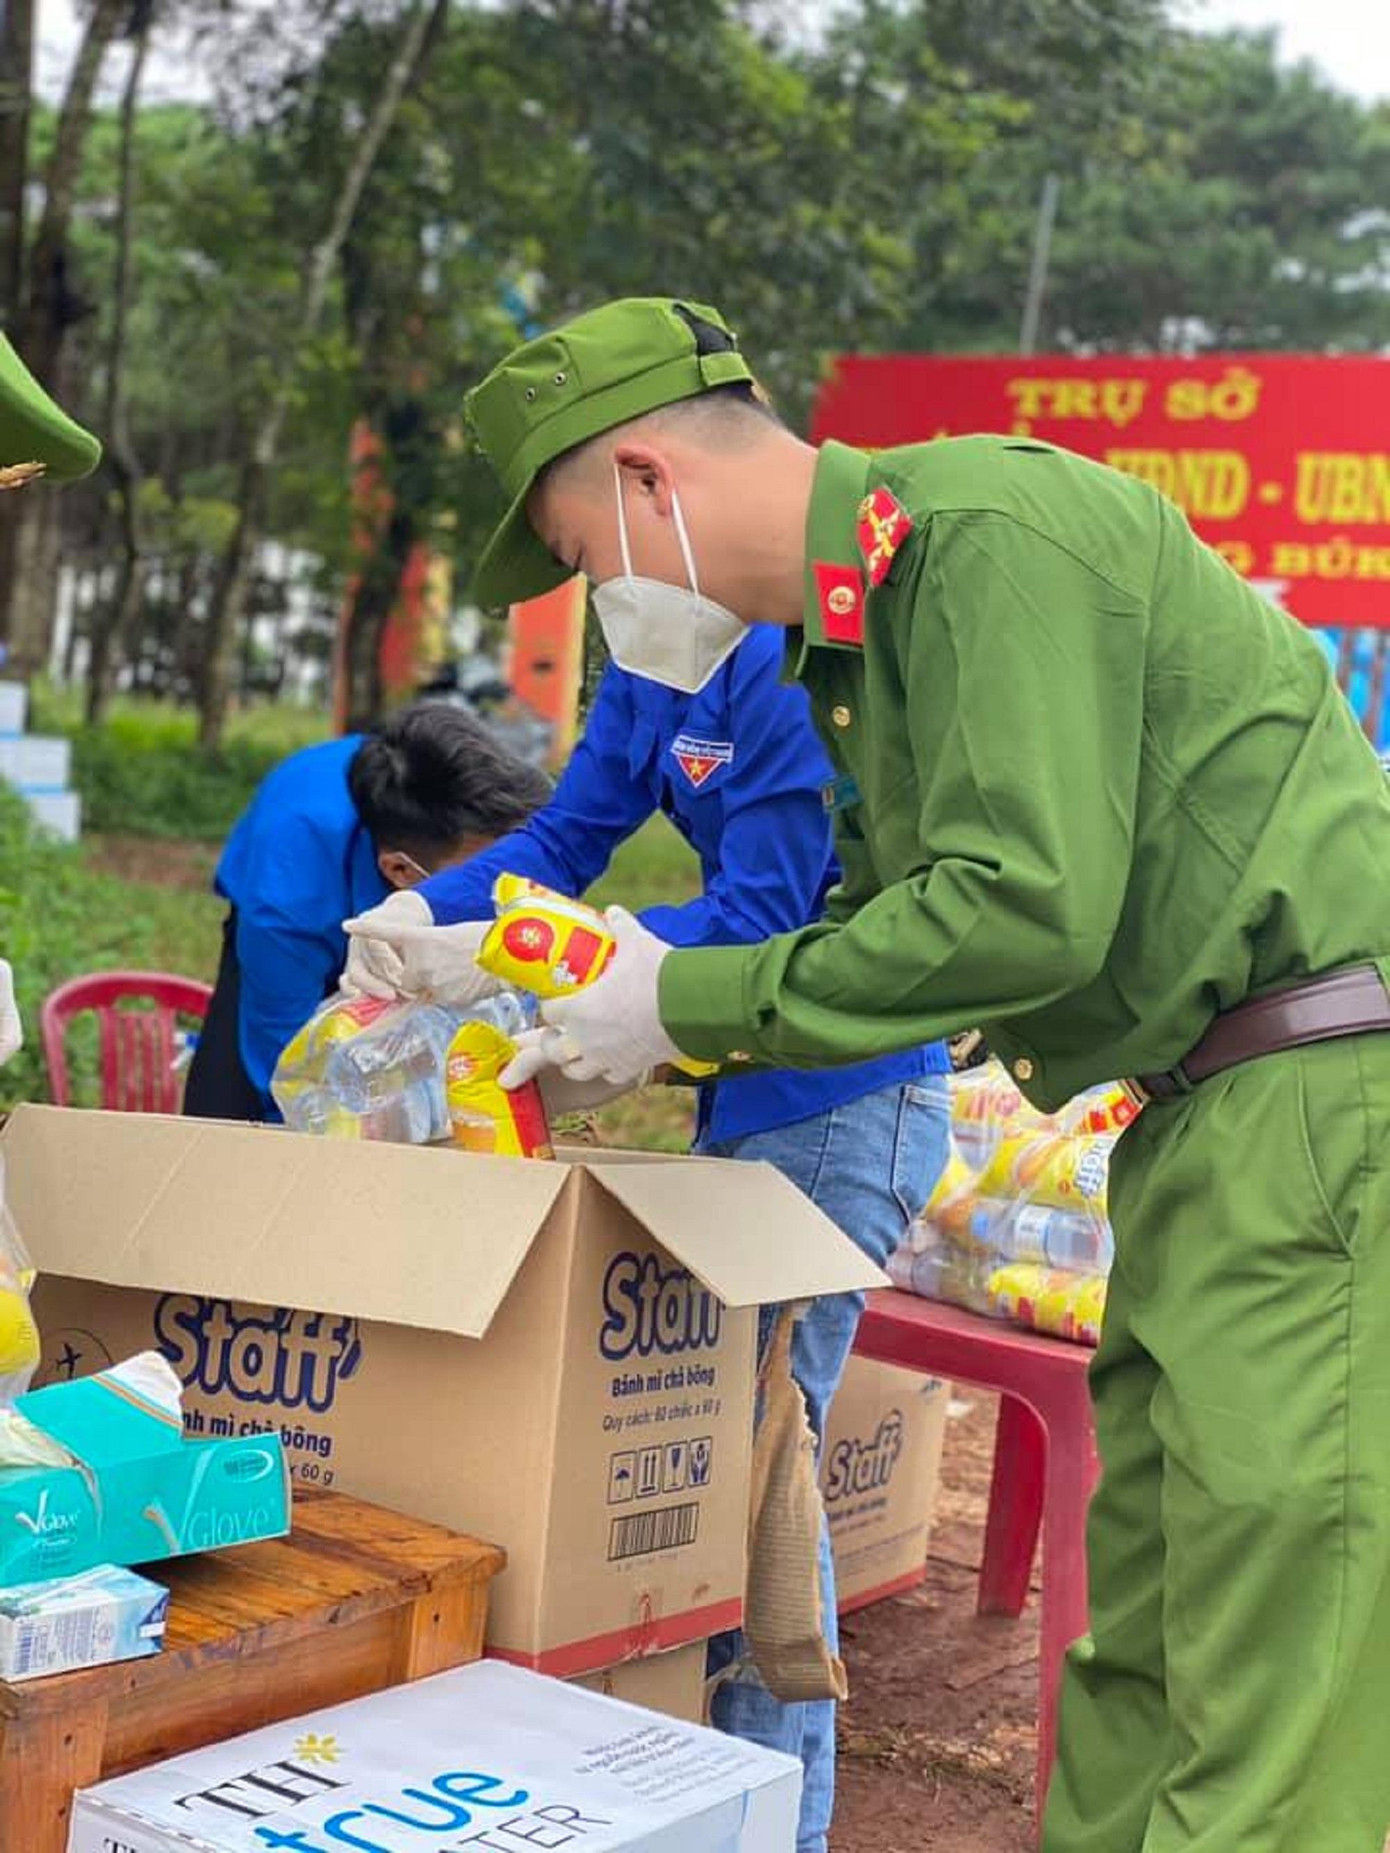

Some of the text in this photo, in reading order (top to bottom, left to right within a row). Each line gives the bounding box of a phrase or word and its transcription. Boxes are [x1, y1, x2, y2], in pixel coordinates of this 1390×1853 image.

[1006, 367, 1262, 428] TRỤ SỞ
[210, 1411, 235, 1437] mì
[280, 1423, 332, 1458] bông
[301, 1463, 320, 1480] 60
[323, 1469, 334, 1486] g
[172, 1760, 351, 1819] TH
[437, 1804, 613, 1853] TER
